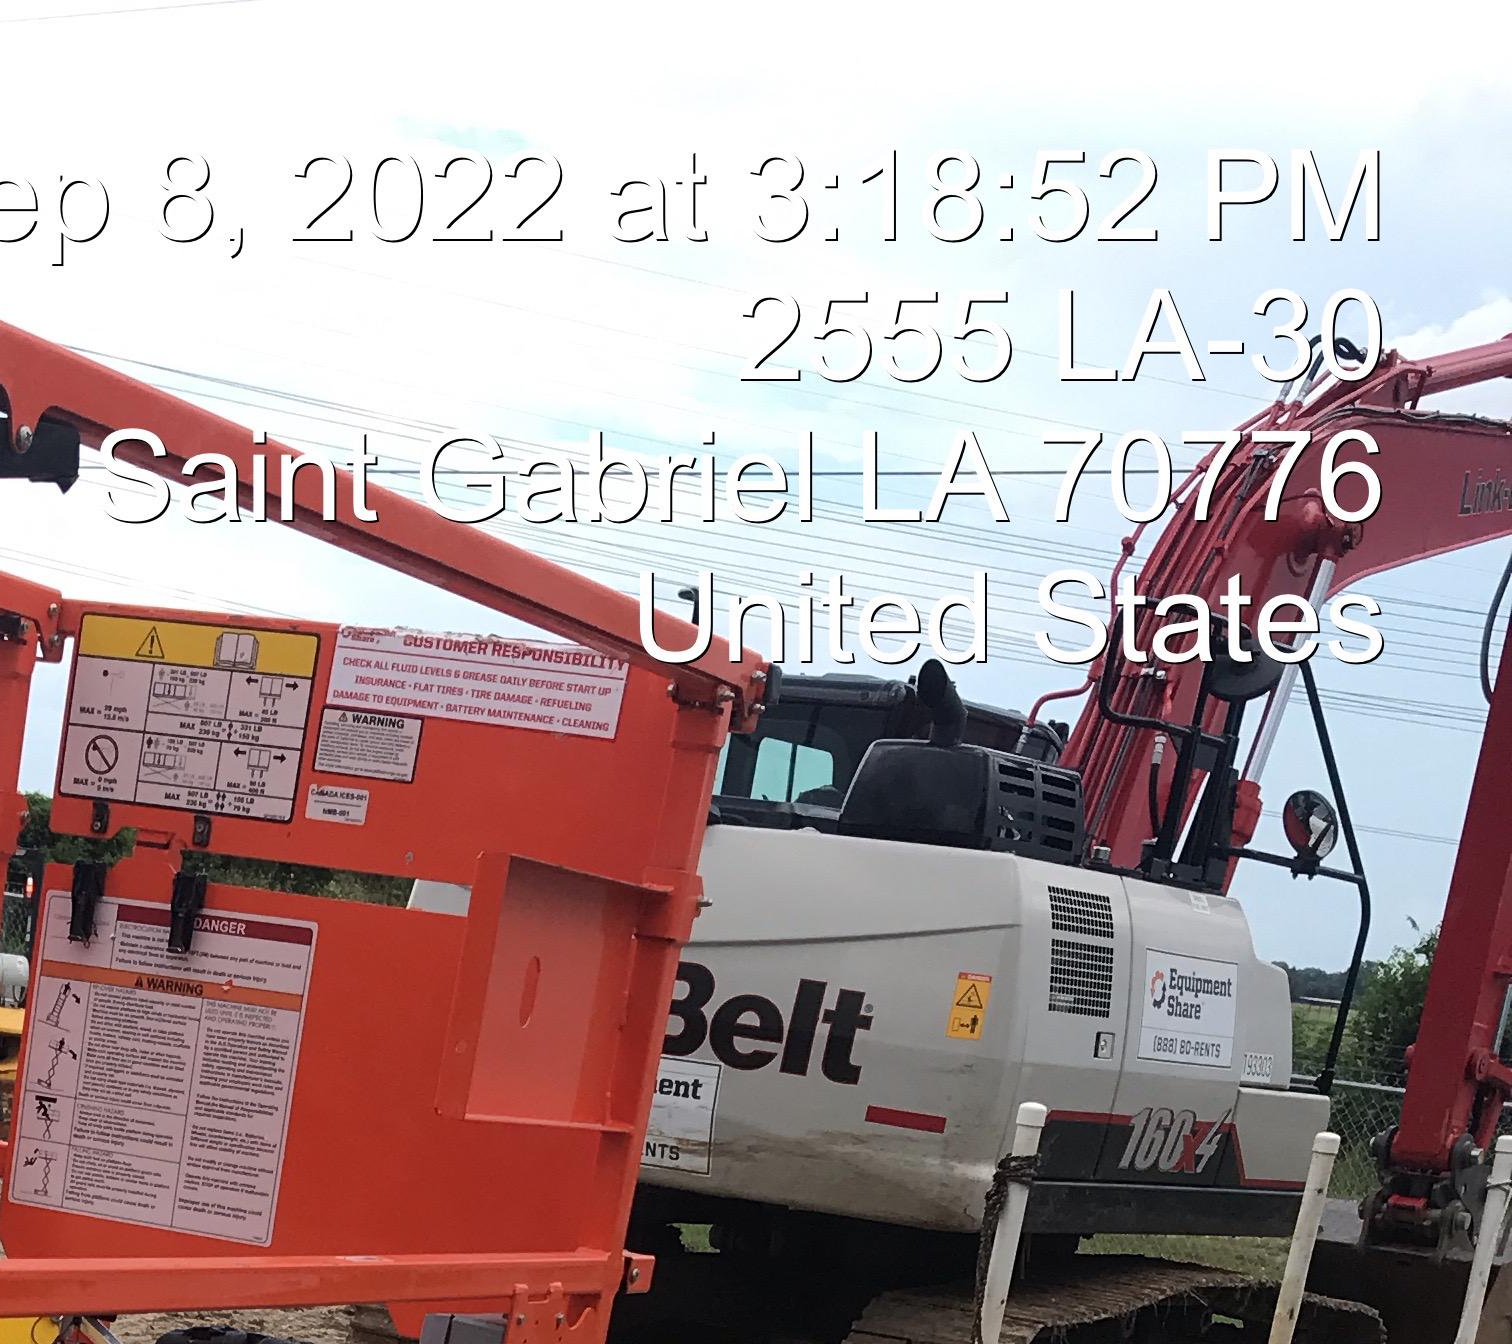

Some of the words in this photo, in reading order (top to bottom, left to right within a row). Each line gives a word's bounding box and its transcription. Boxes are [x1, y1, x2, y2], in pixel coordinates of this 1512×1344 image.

[403, 634, 488, 656] CUSTOMER
[491, 642, 627, 672] RESPONSIBILITY
[343, 656, 371, 670] CHECK
[374, 660, 389, 671] ALL
[391, 661, 418, 674] FLUID
[419, 664, 452, 678] LEVELS
[462, 669, 497, 684] GREASE
[499, 673, 528, 687] DAILY
[529, 676, 563, 691] BEFORE
[565, 680, 596, 694] START
[598, 685, 612, 696] UP
[354, 675, 406, 690] INSURANCE
[413, 682, 434, 694] FLAT
[436, 684, 464, 697] TIRES
[470, 688, 492, 699] TIRE
[494, 690, 533, 706] DAMAGE
[539, 696, 592, 712] REFUELING
[333, 689, 370, 703] DAMAGE
[372, 693, 384, 703] TO
[385, 695, 439, 710] EQUIPMENT
[445, 702, 486, 716] BATTERY
[487, 707, 555, 726] MAINTENANCE
[561, 716, 610, 732] CLEANING
[352, 713, 405, 729] WARNING
[193, 917, 246, 936] DANGER
[147, 976, 203, 996] WARNING
[1169, 967, 1232, 998] Equipment
[1166, 994, 1202, 1020] Share
[1152, 1034, 1178, 1055] (888)
[1179, 1039, 1221, 1059] 80-RENTS
